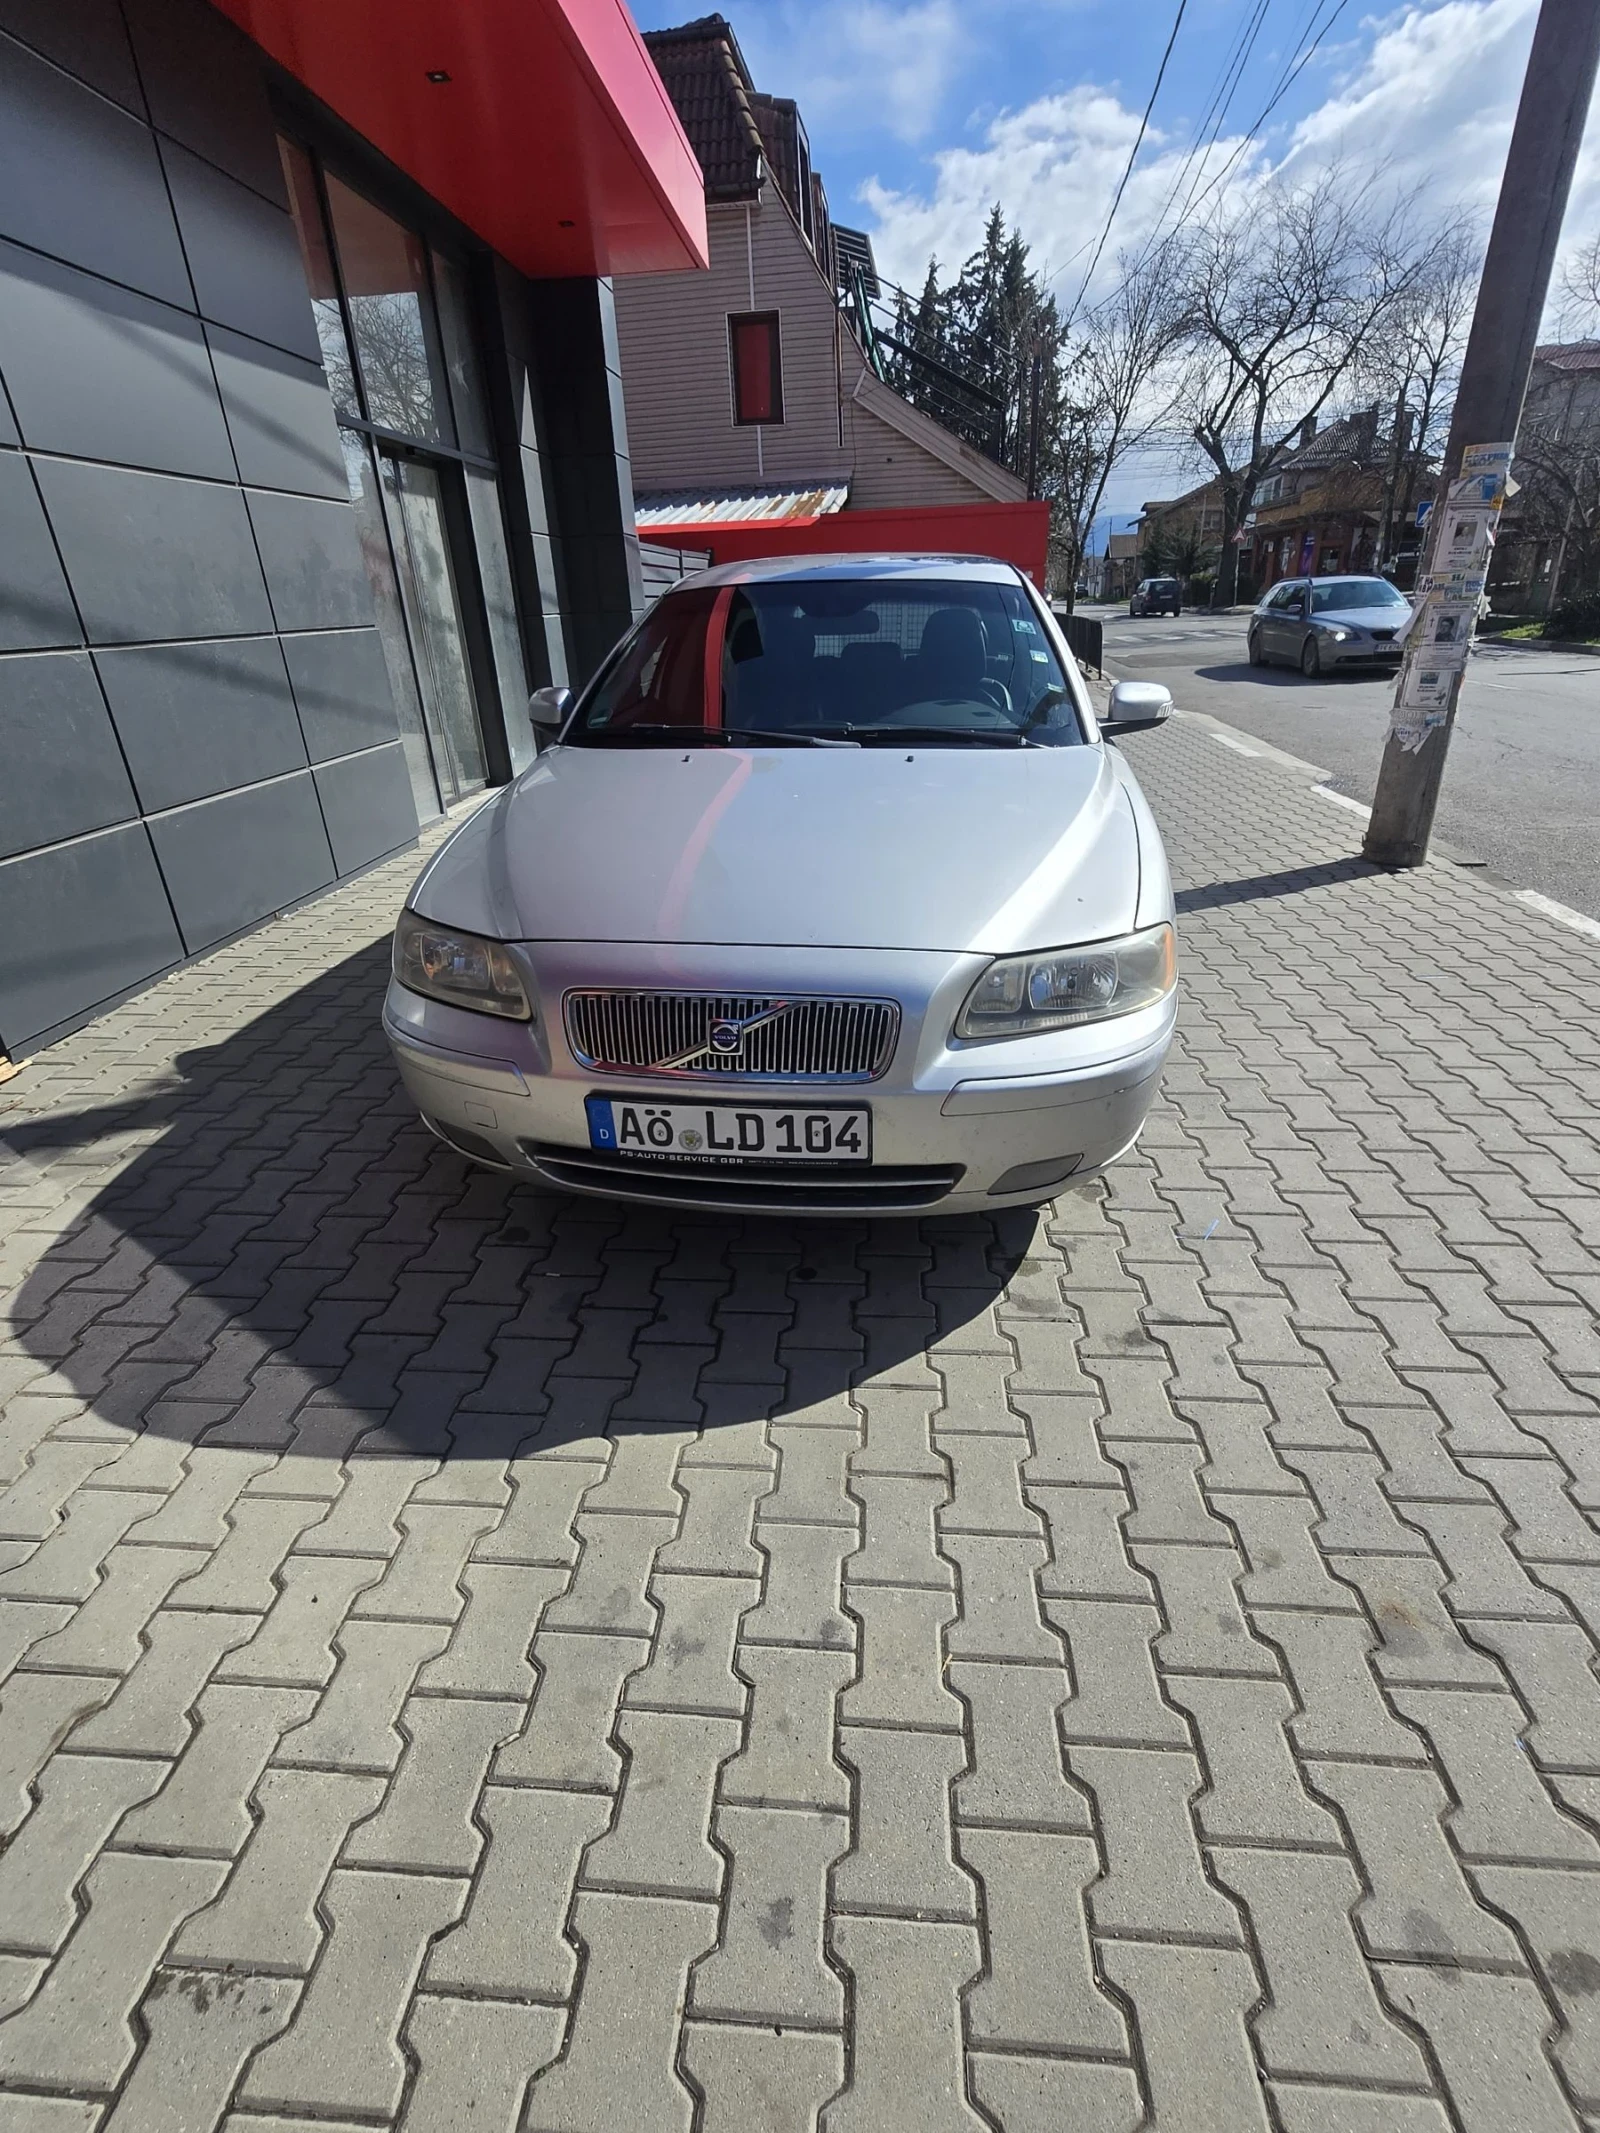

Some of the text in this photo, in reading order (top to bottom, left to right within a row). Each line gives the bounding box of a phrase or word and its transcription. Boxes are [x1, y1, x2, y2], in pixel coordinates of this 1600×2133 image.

[620, 1107, 674, 1147] AÖ
[599, 1128, 610, 1140] D
[720, 1157, 744, 1165] GBR
